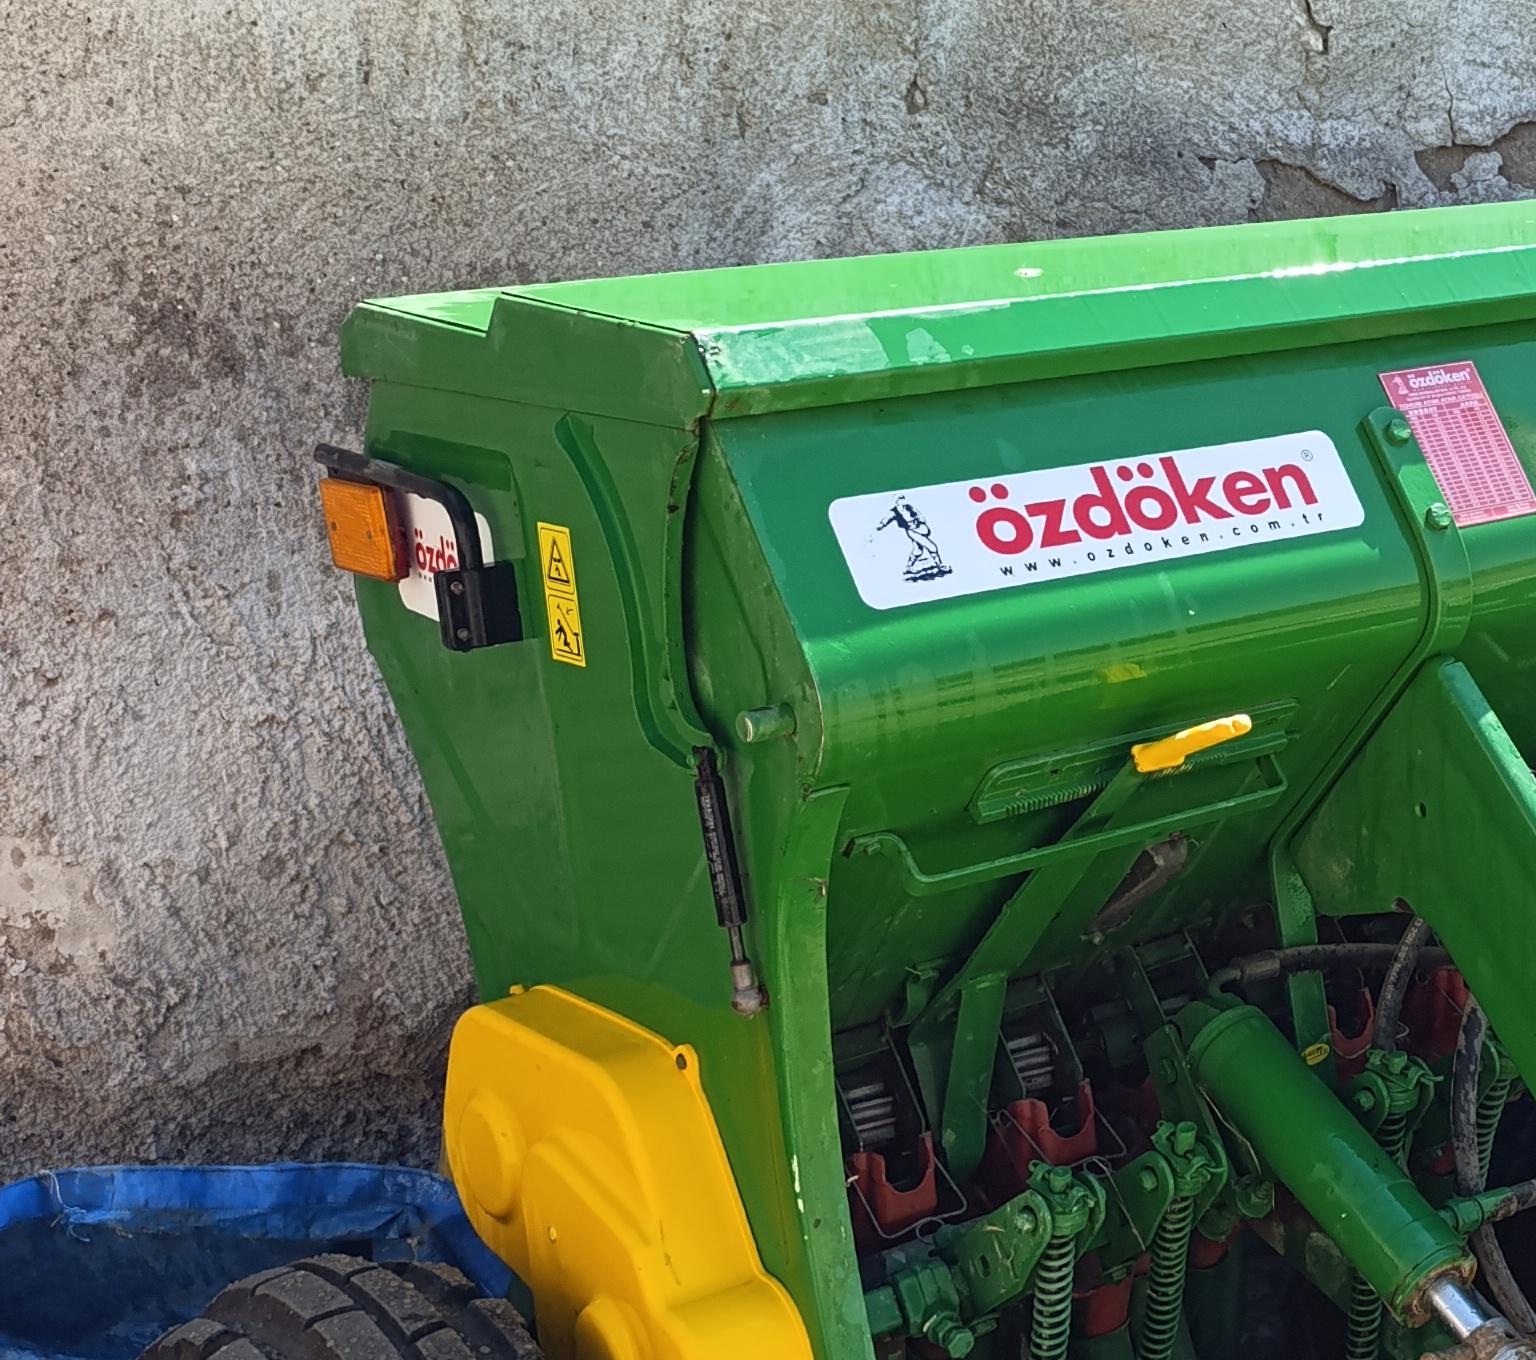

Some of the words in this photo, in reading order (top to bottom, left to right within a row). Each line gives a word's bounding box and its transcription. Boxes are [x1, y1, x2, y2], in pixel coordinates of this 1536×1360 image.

[1407, 368, 1471, 389] özdöken
[967, 455, 1320, 556] özdöken
[999, 512, 1325, 578] www.ozdoken.com.tr
